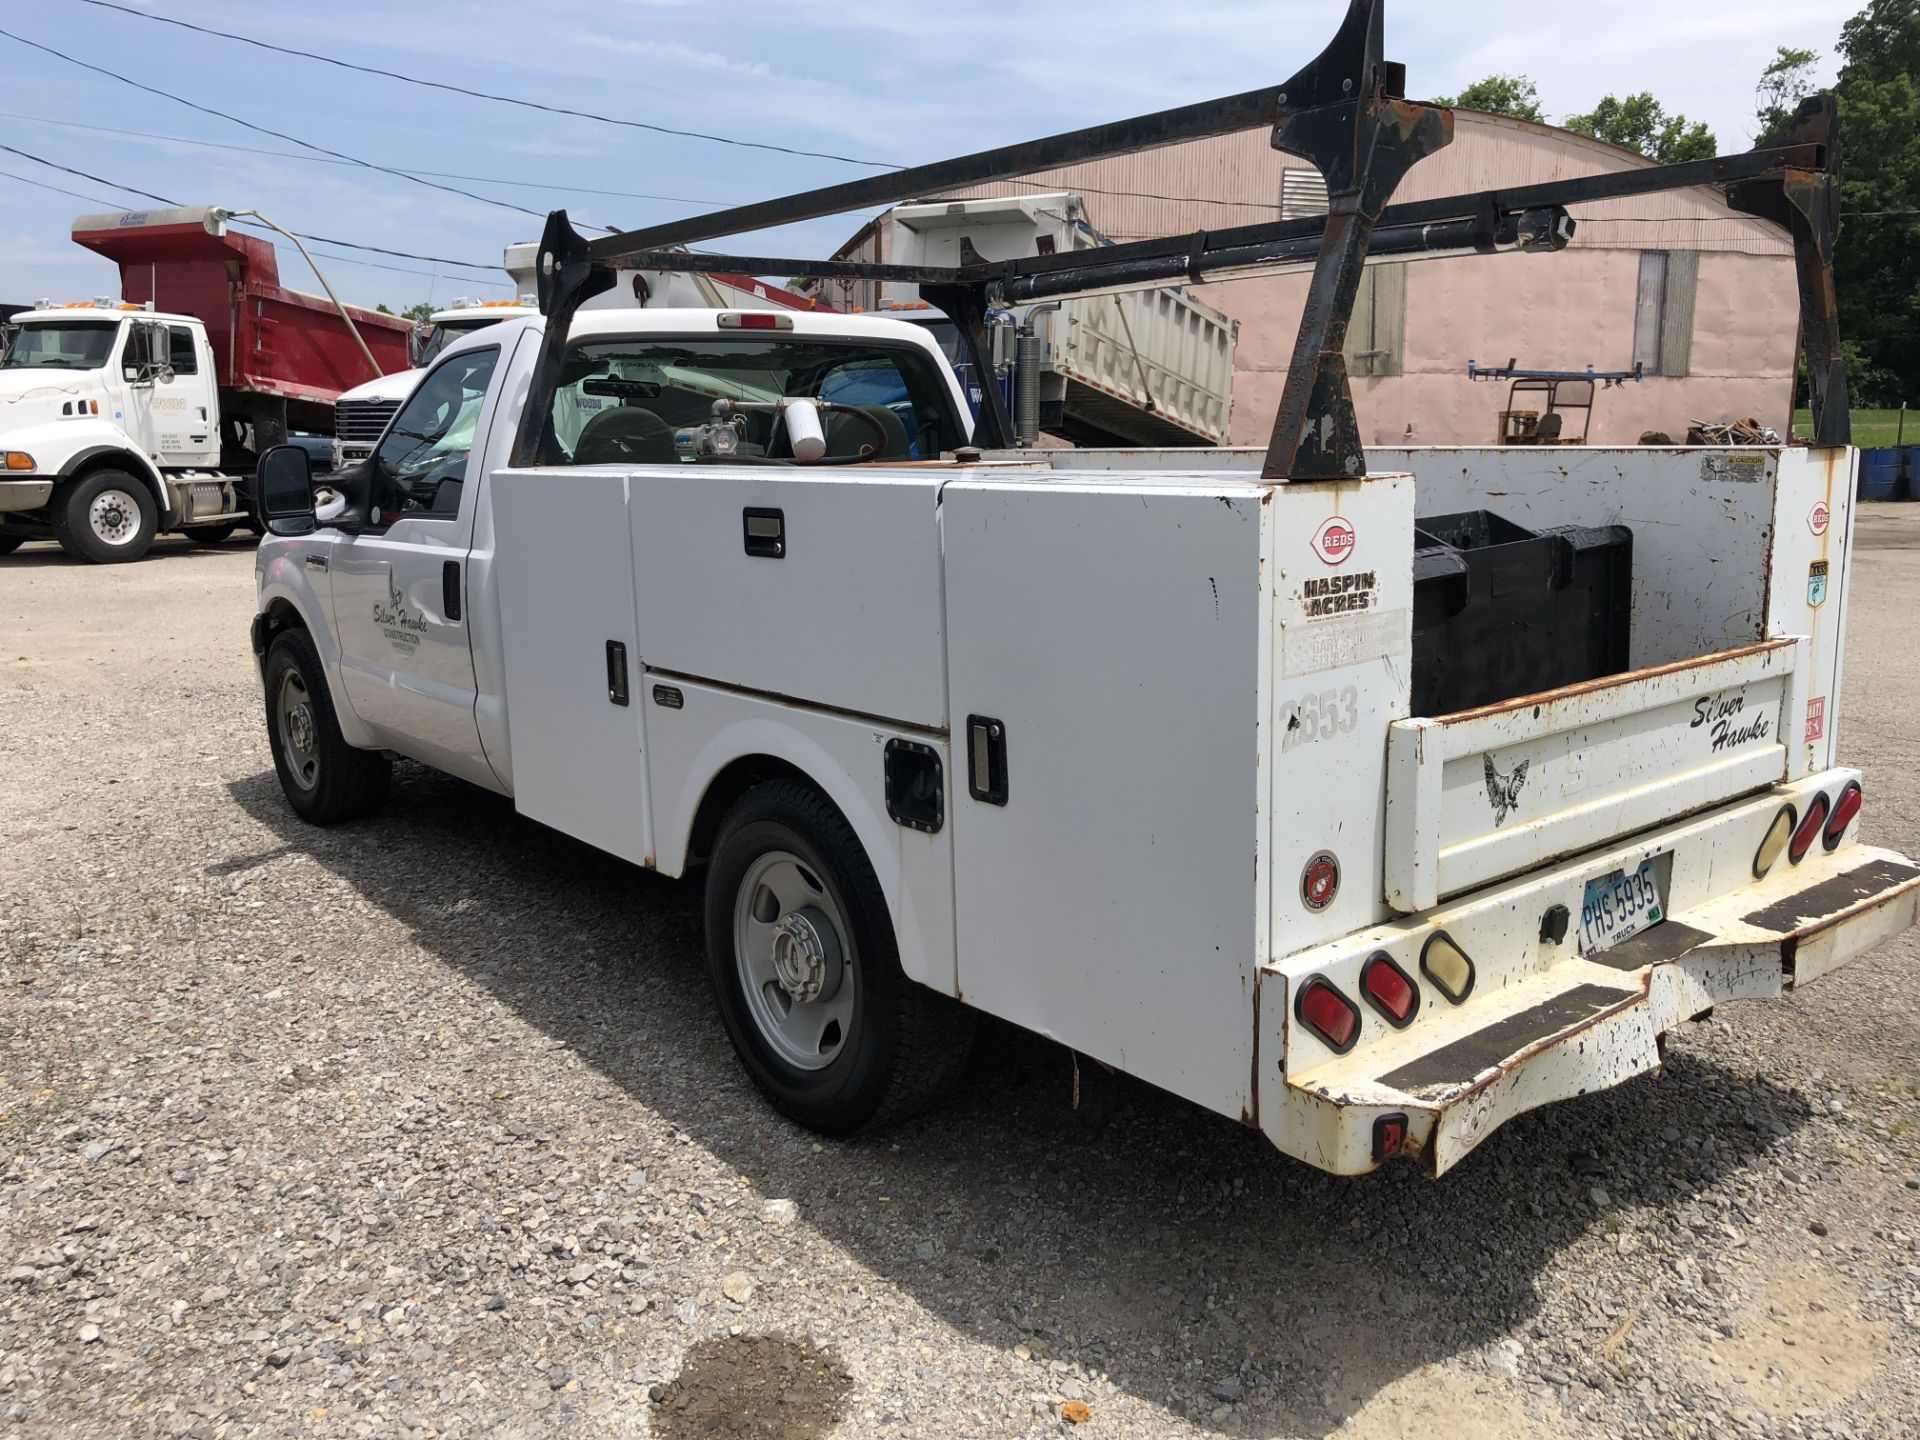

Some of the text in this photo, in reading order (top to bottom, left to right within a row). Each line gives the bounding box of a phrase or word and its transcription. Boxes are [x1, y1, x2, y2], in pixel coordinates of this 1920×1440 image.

[1813, 513, 1829, 524] REDS
[1324, 533, 1353, 548] REDS
[1304, 572, 1375, 598] HASPIN
[1306, 591, 1369, 617] ACRES
[374, 604, 427, 633] Silver Hawke
[384, 628, 421, 646] CONSTRUCTION
[1280, 684, 1358, 755] 2653
[1690, 692, 1746, 729] Silver
[1710, 710, 1770, 754] Hawke
[1583, 867, 1655, 945] PHS 5935
[1611, 922, 1637, 944] TRUCK
